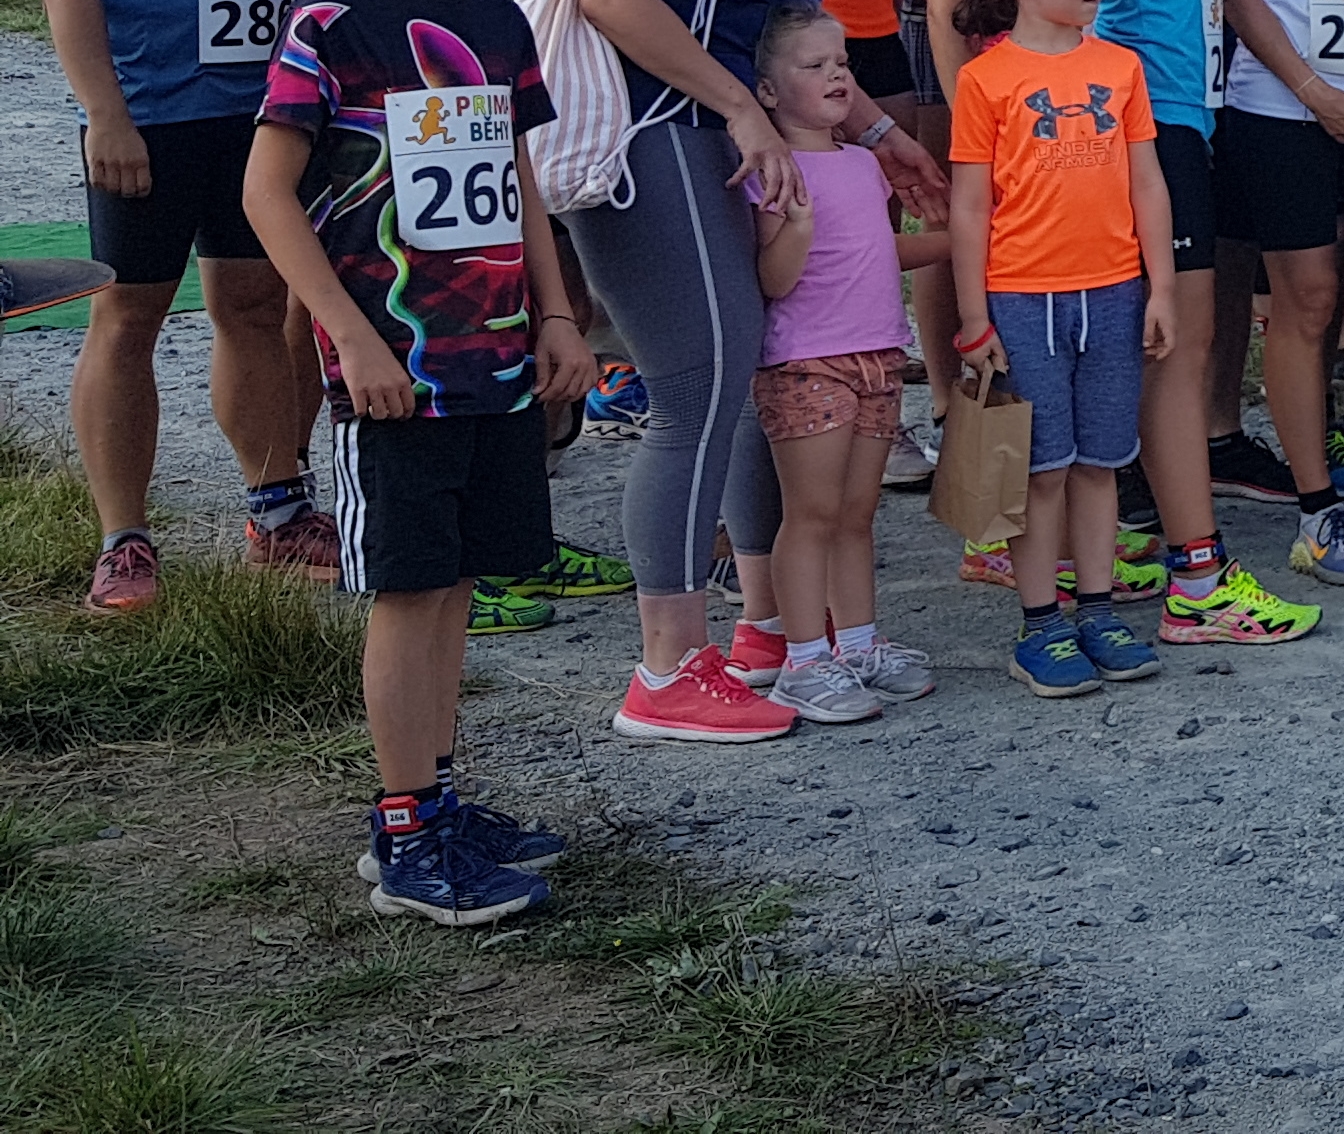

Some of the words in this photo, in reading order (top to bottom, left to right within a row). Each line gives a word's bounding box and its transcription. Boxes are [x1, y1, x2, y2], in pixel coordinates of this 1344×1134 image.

[470, 116, 509, 142] BĚHY
[1034, 152, 1112, 173] ARMOU
[411, 160, 519, 231] 266
